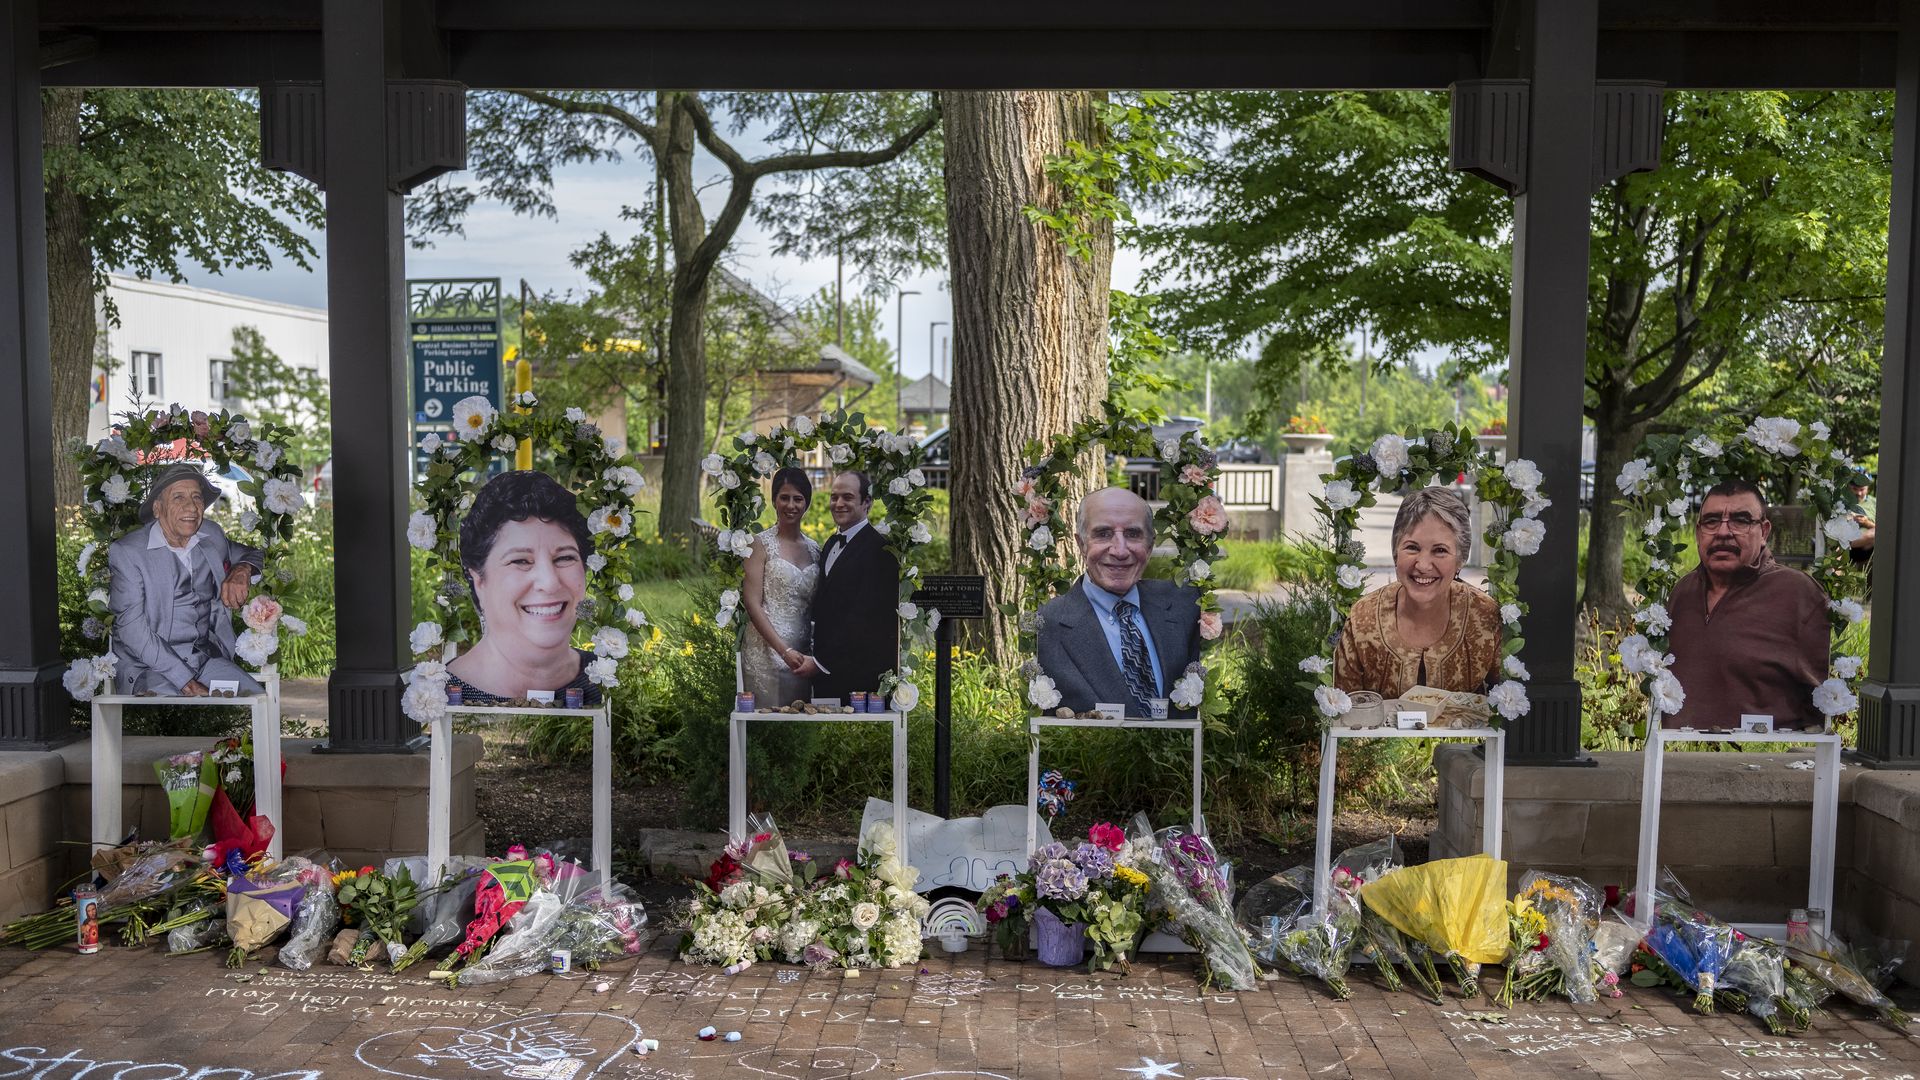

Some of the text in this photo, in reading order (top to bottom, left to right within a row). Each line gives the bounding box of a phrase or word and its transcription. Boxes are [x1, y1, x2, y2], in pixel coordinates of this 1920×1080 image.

[431, 324, 492, 332] HIGHLAND PARK
[470, 341, 494, 349] District
[424, 349, 448, 357] Parking
[449, 349, 472, 357] Garage
[423, 361, 475, 376] Public
[424, 378, 489, 395] Parking
[633, 969, 727, 982] LOVE
[1042, 982, 1104, 993] YOU
[281, 991, 363, 1005] their
[302, 1003, 497, 1023] be a blessing
[1463, 1033, 1497, 1045] A
[1720, 1038, 1808, 1050] LOVE
[1720, 1067, 1845, 1080] Praying
